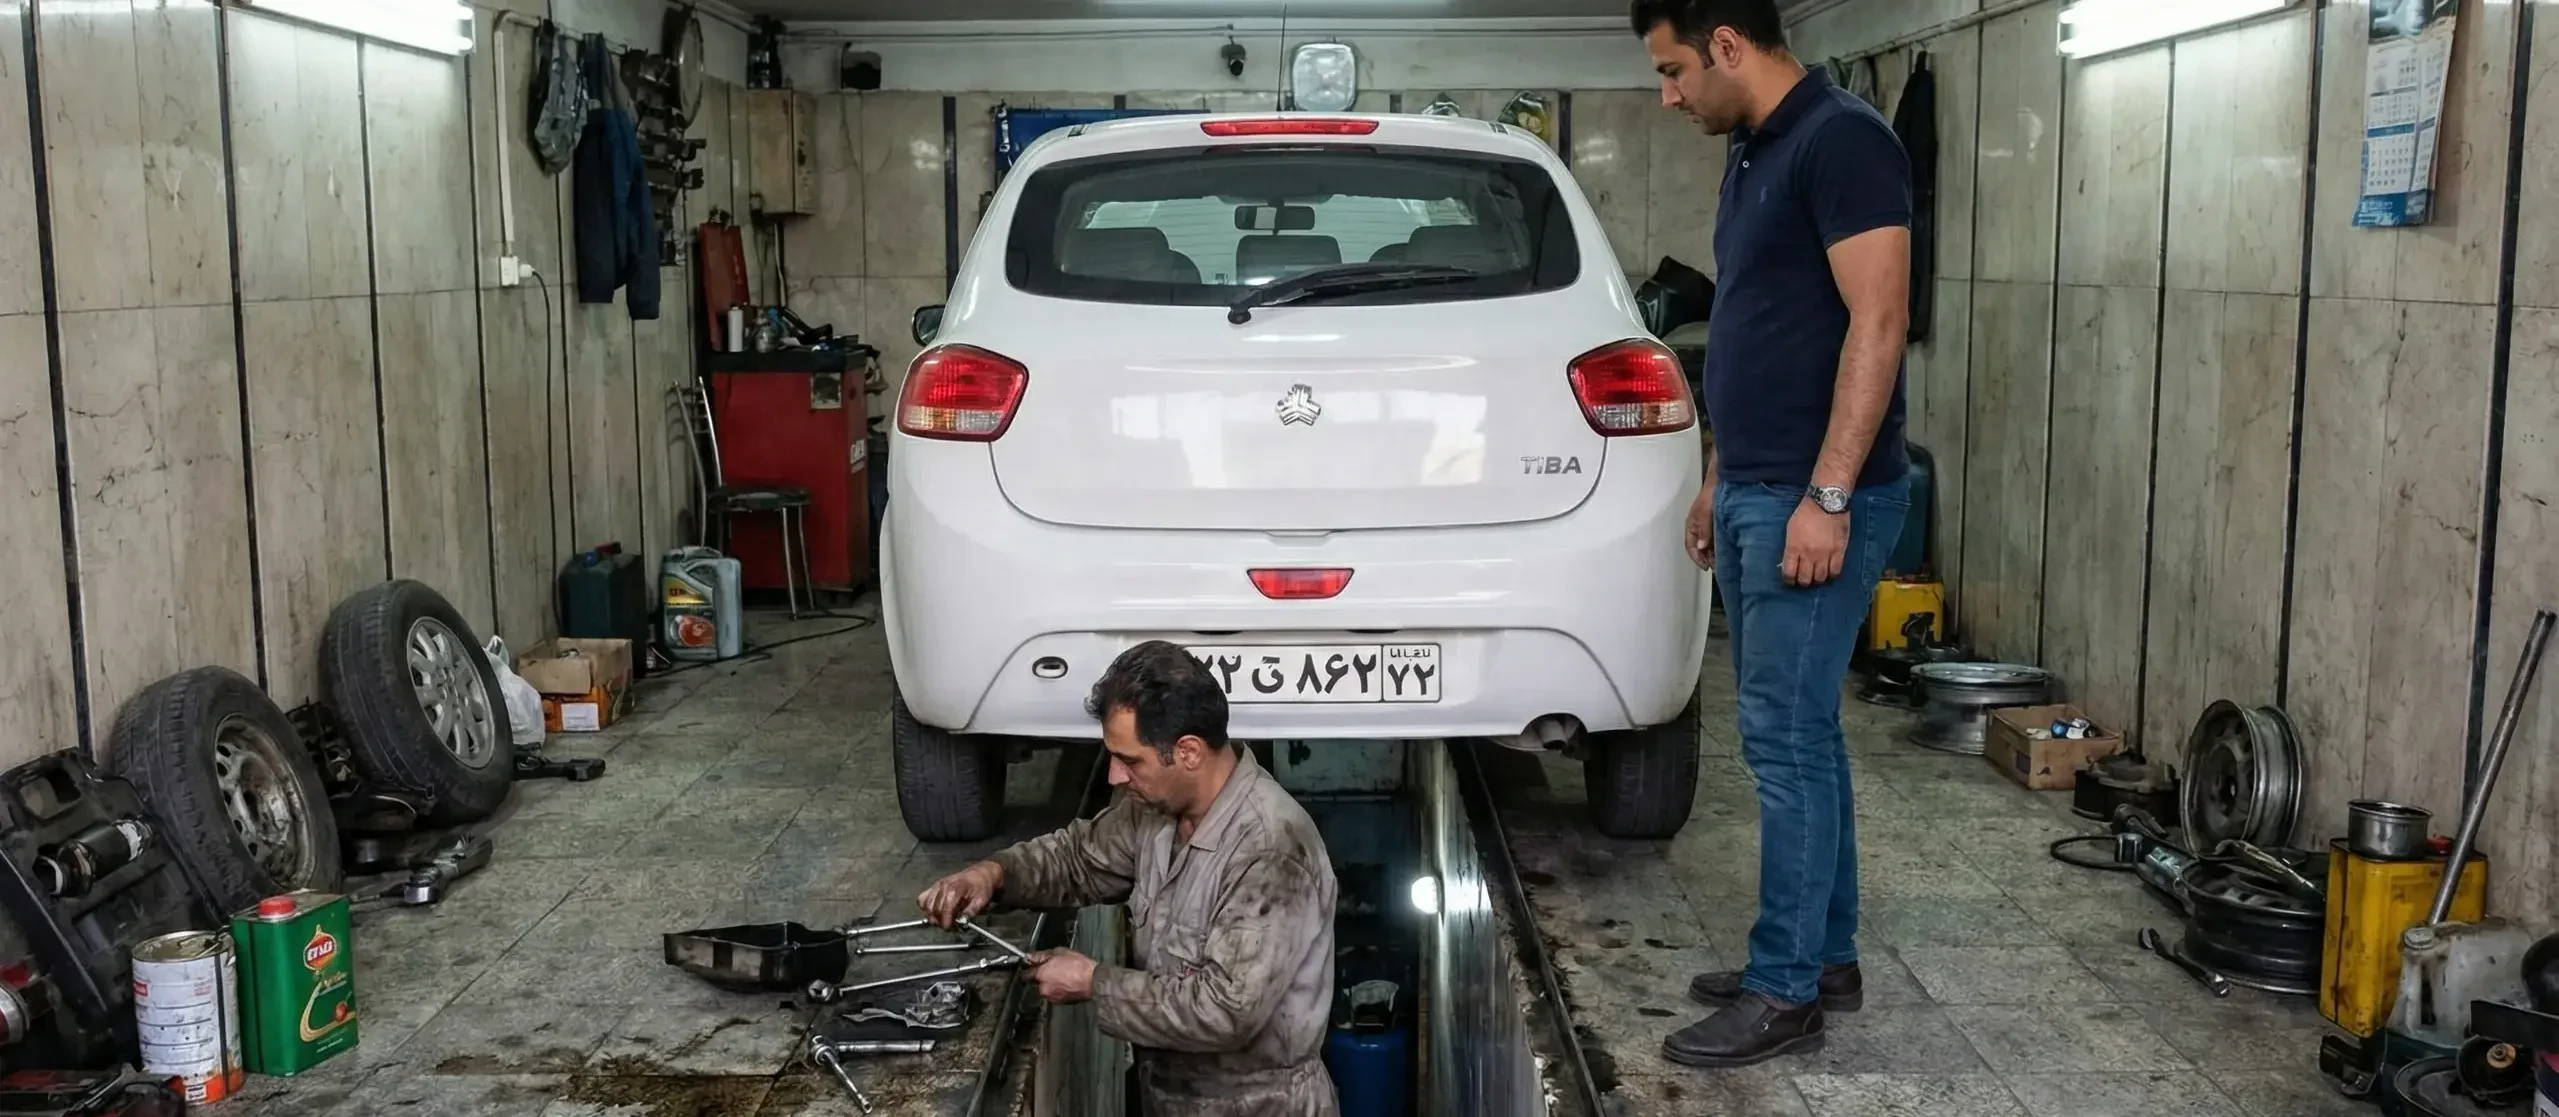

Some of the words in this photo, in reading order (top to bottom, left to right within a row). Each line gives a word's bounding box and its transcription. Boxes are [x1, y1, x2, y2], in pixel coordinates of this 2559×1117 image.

[1520, 455, 1582, 475] TIBA
[1296, 653, 1377, 694] ۸۶۲
[1387, 663, 1435, 695] ۷۲
